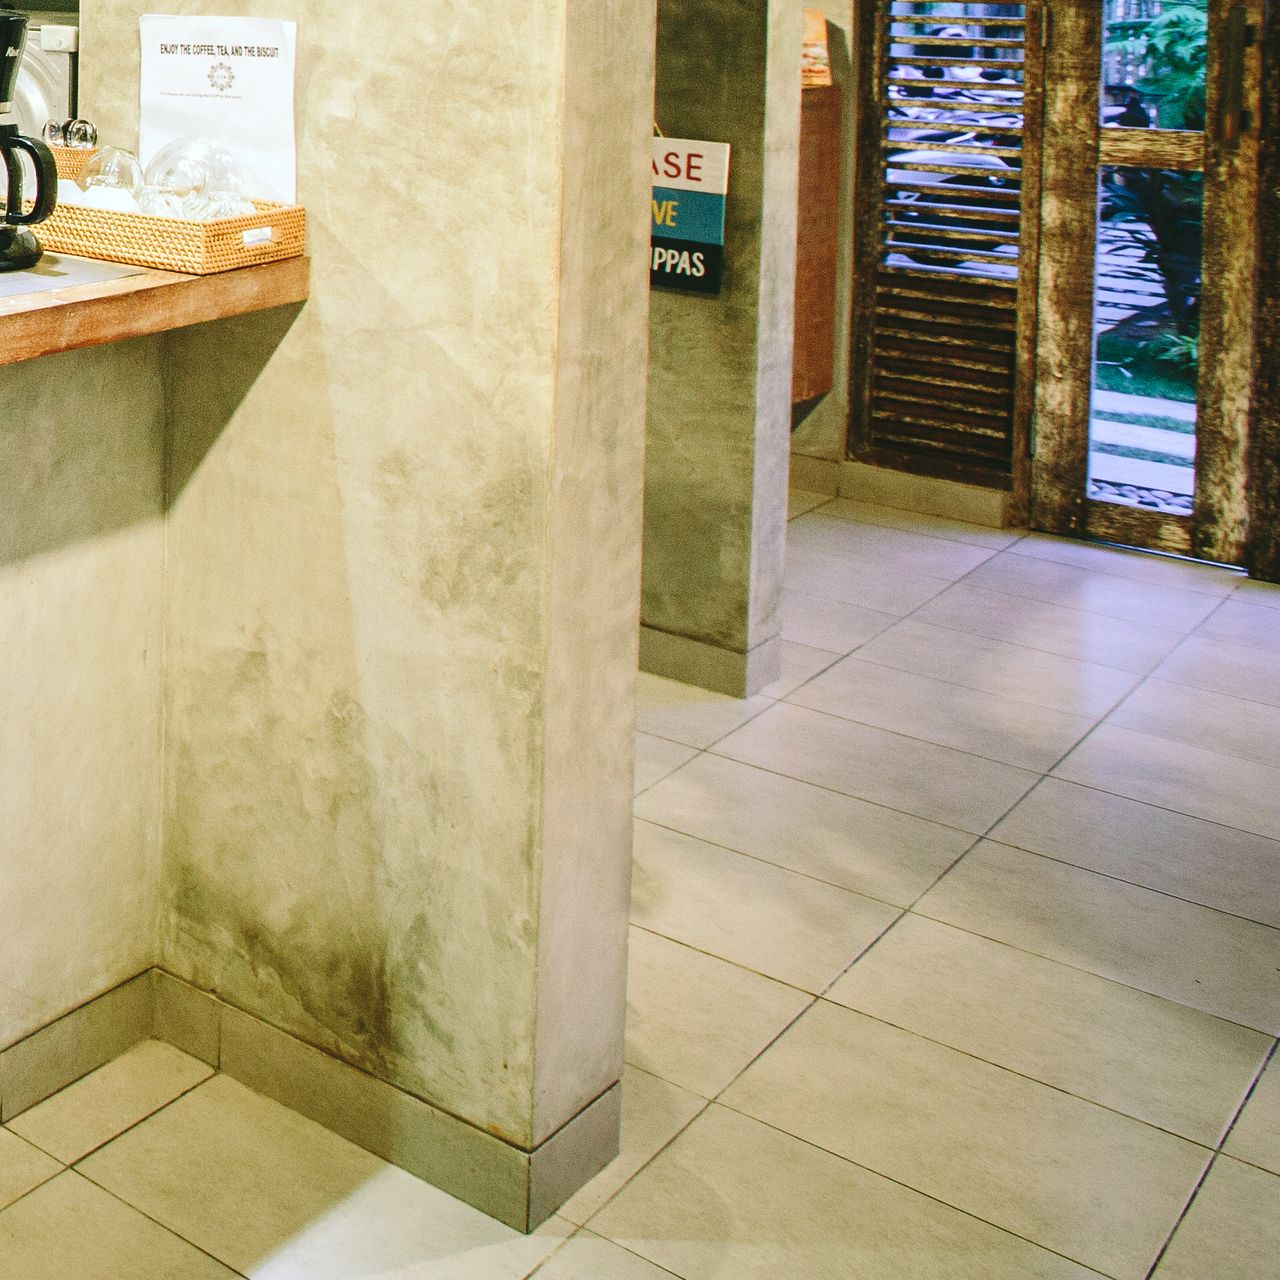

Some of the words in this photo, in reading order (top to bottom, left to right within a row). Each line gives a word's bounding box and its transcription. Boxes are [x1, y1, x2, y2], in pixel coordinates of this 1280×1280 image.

[160, 43, 178, 54] ENJOY
[180, 44, 191, 55] THE
[193, 44, 216, 57] COFFEE,
[217, 45, 229, 58] TEA,
[231, 46, 243, 56] AND
[244, 46, 255, 57] THE
[257, 47, 278, 58] BISCUIT
[651, 200, 679, 227] VE
[652, 247, 705, 277] PPAS
